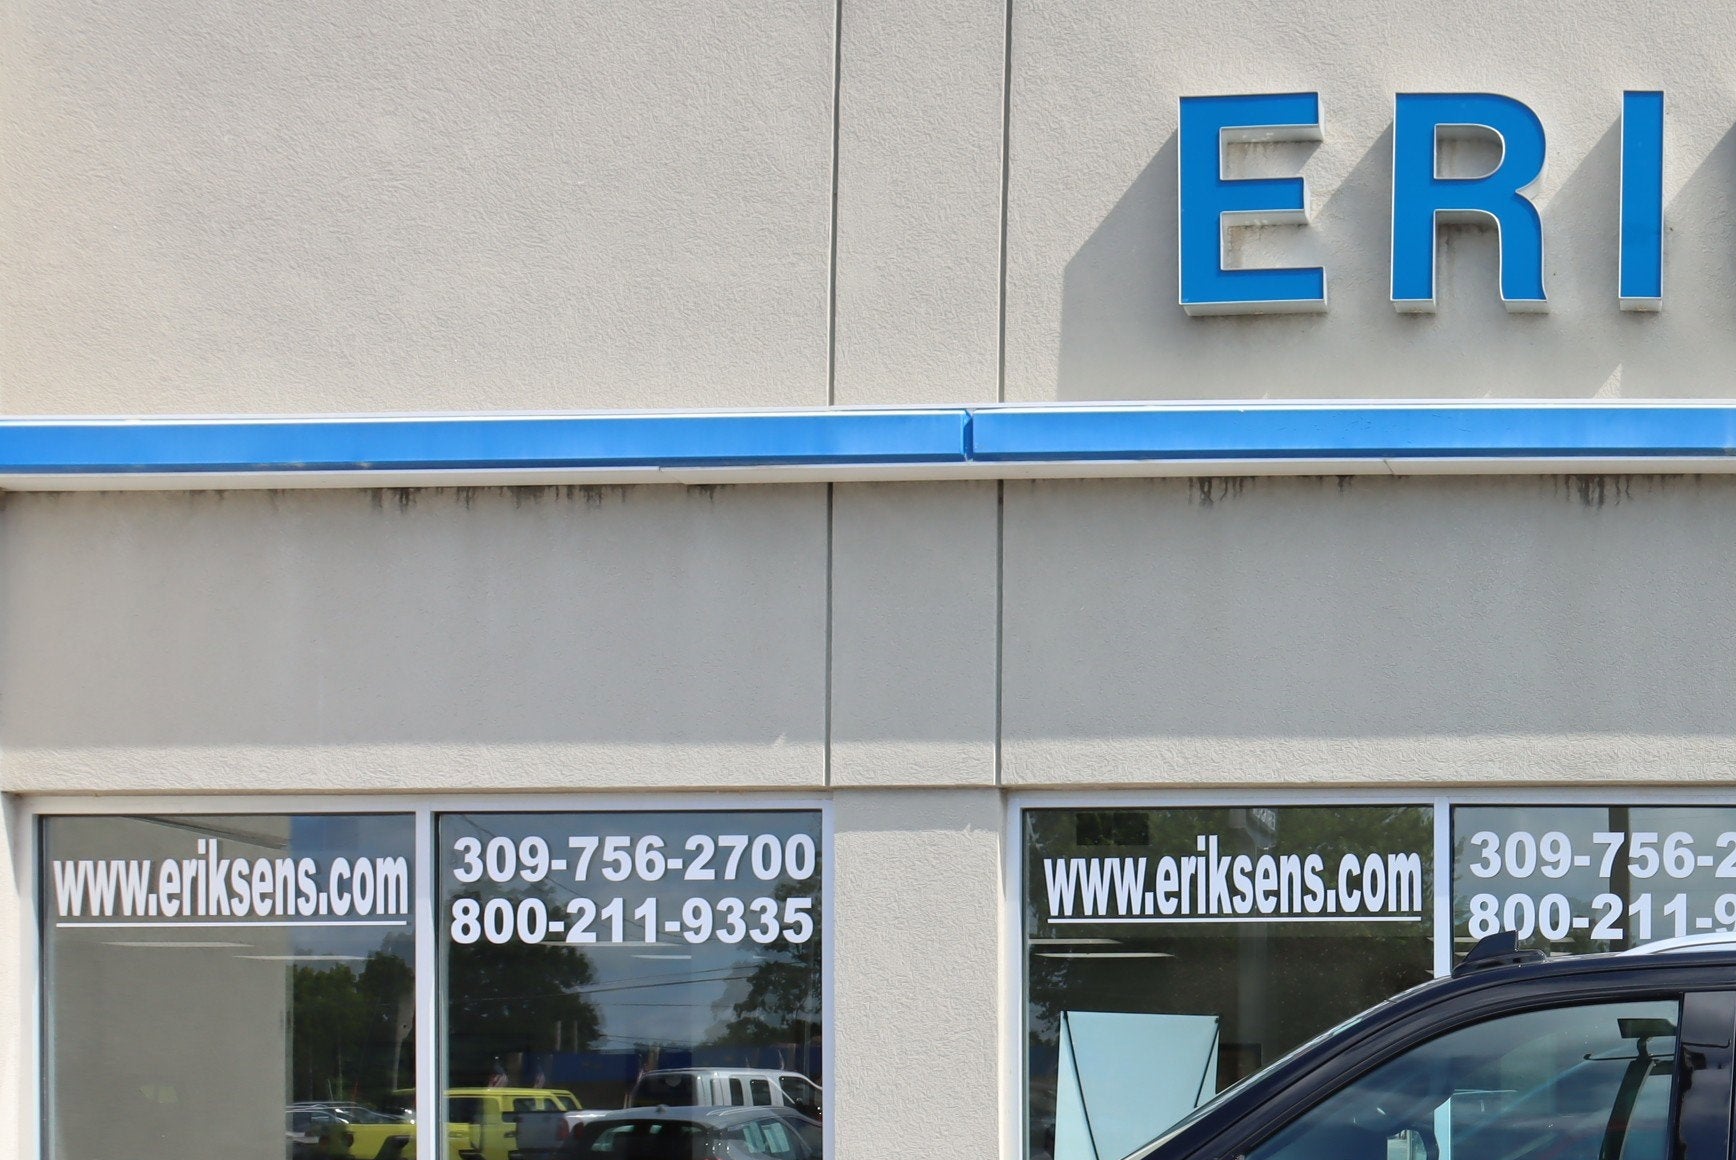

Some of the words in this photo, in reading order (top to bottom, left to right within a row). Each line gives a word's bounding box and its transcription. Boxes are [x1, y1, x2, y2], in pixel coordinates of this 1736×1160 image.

[54, 838, 409, 917] www.eriksens.com
[452, 834, 817, 884] 309-756-2700
[1044, 835, 1423, 916] www.eriksens.com
[450, 897, 815, 946] 800-211-9335
